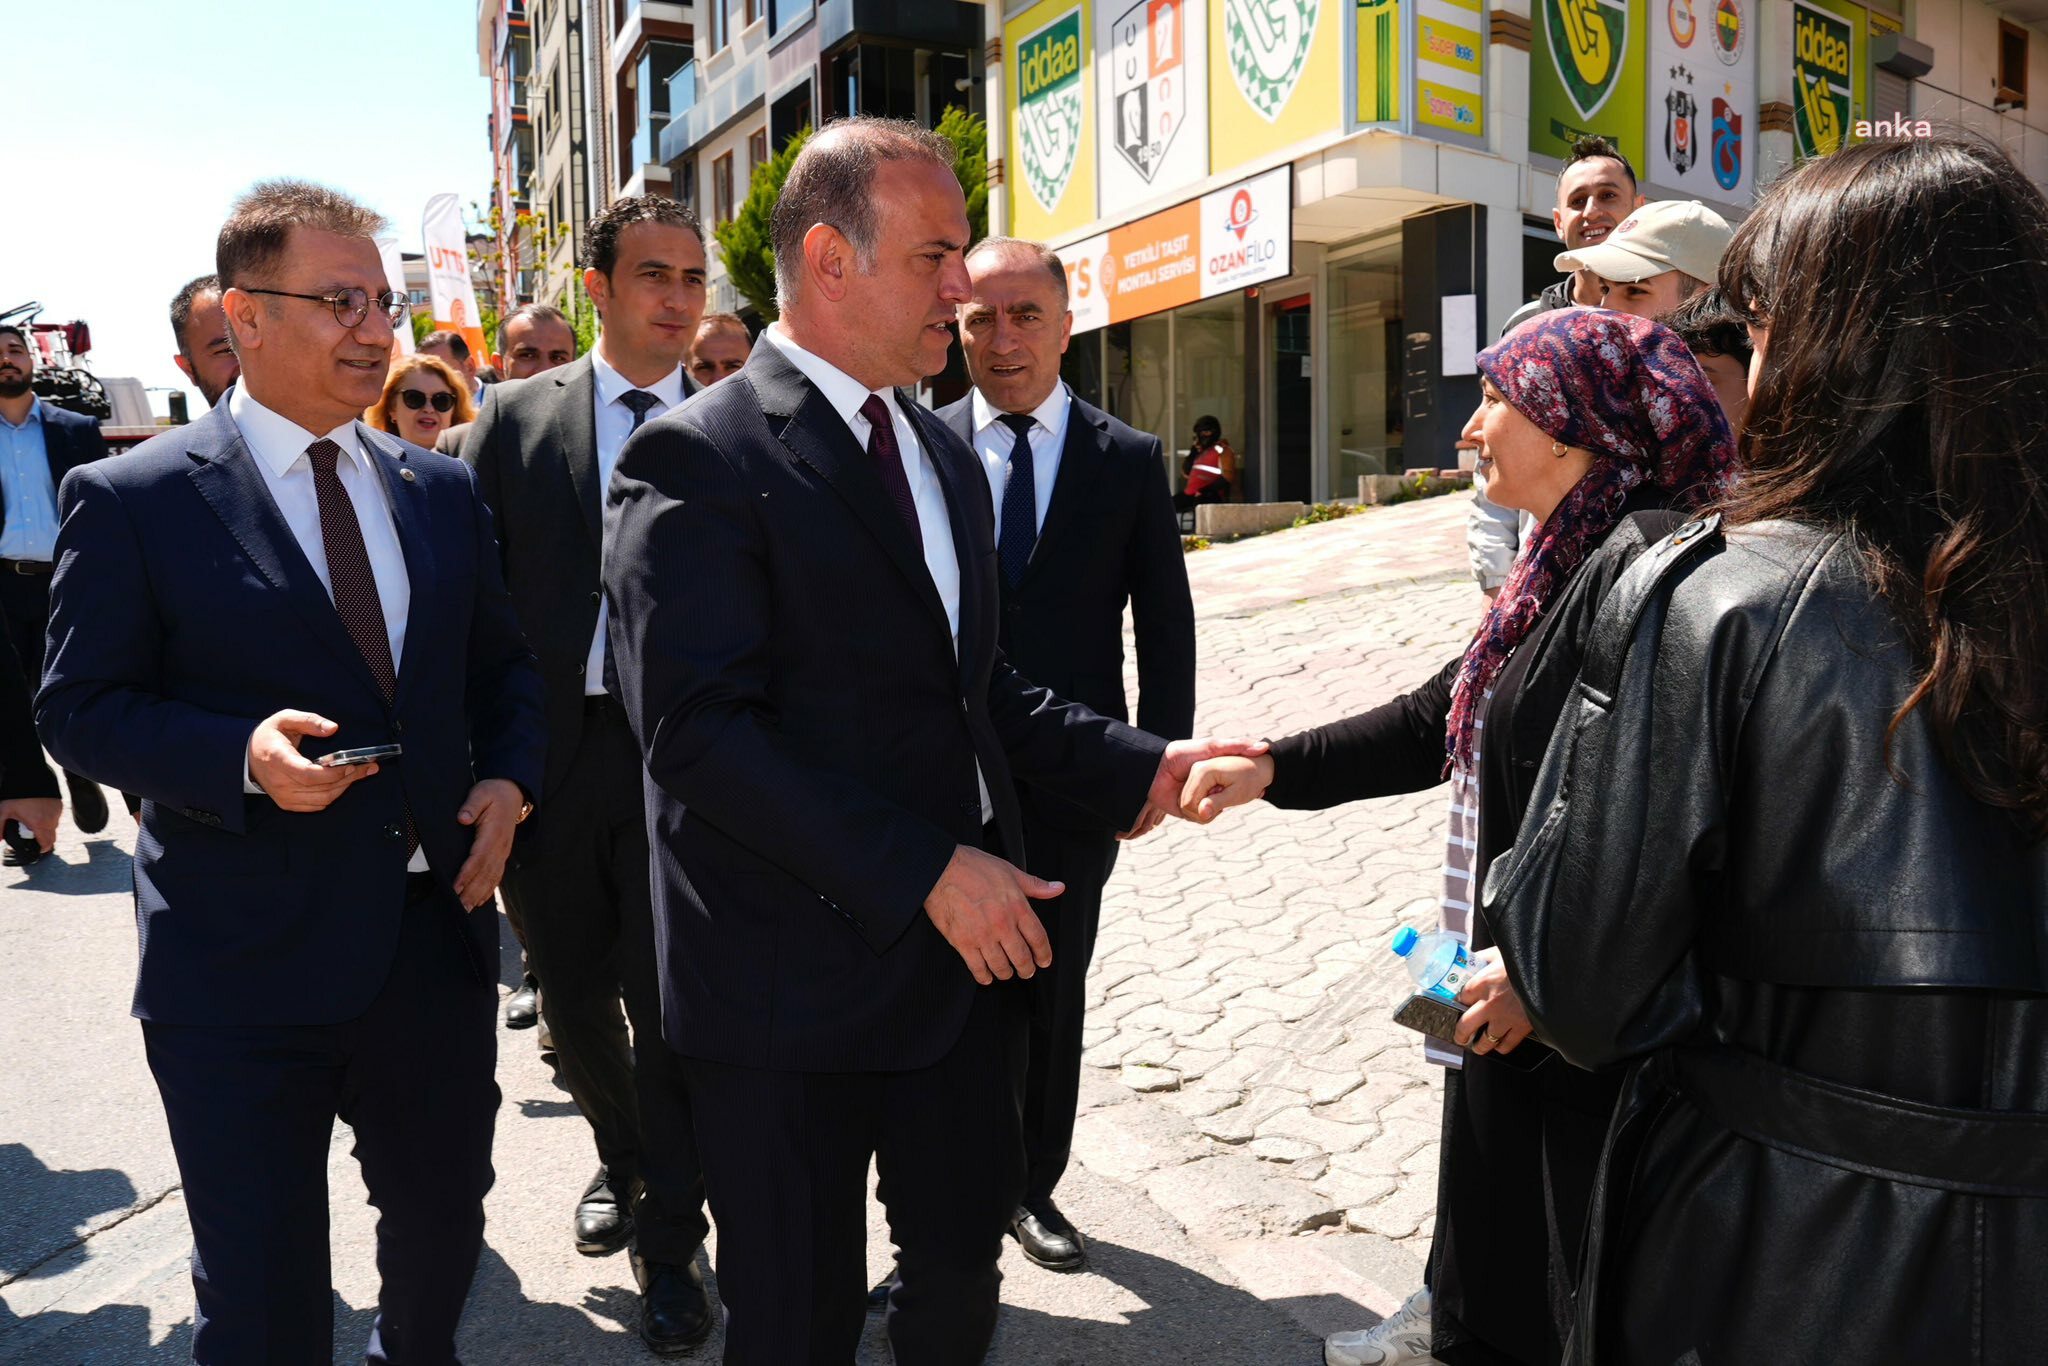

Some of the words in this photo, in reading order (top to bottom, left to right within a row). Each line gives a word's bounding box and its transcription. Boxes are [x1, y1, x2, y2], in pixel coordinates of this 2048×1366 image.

[1021, 34, 1078, 97] iddaa
[1796, 11, 1848, 76] iddaa
[1117, 268, 1157, 295] MONTAJ
